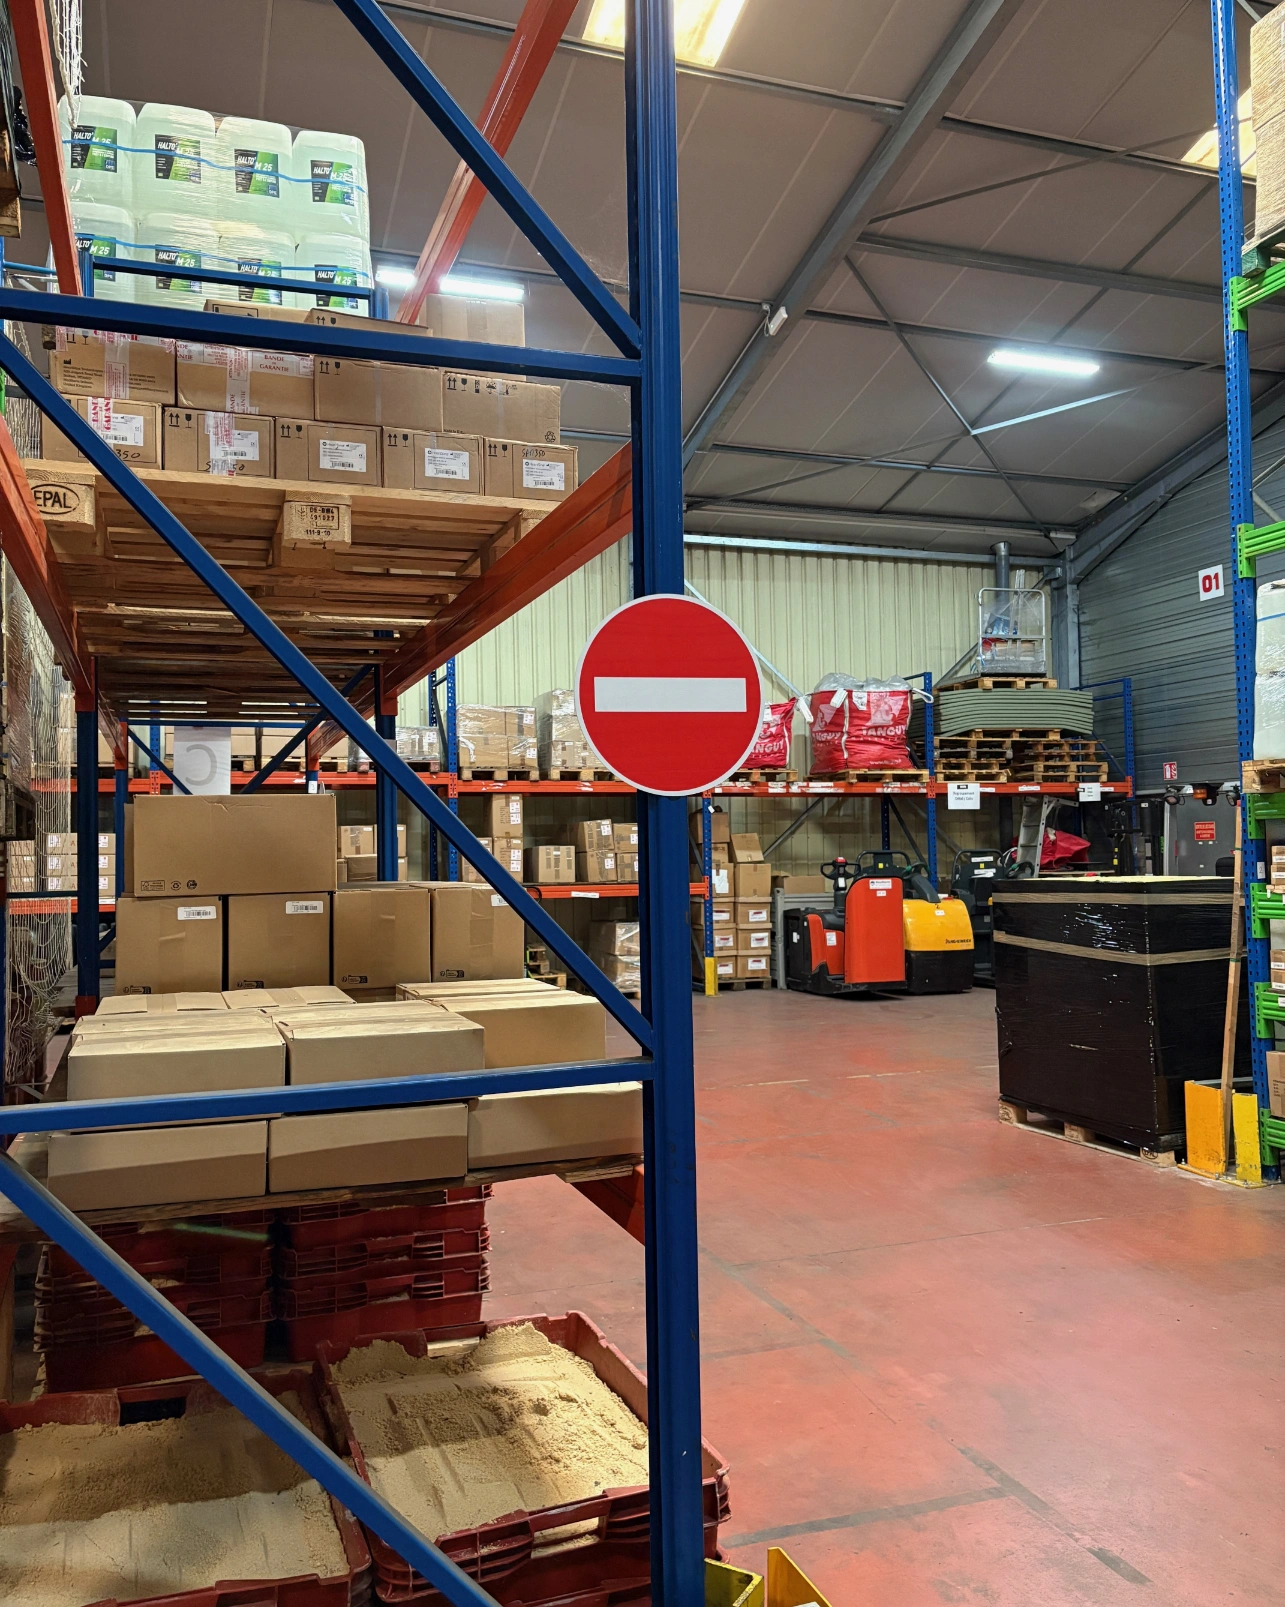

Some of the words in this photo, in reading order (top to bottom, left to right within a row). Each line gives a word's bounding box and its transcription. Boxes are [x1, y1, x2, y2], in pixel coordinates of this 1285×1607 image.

[263, 163, 273, 172] 25
[99, 247, 110, 255] 25
[184, 258, 196, 267] 25
[342, 277, 352, 286] 25
[264, 355, 285, 363] BANDE
[260, 364, 290, 373] GARANTIE
[34, 490, 72, 509] EPAL
[1202, 572, 1220, 593] 01
[862, 725, 907, 737] TANGUY
[812, 732, 841, 742] NGUY
[752, 740, 785, 754] NGUY
